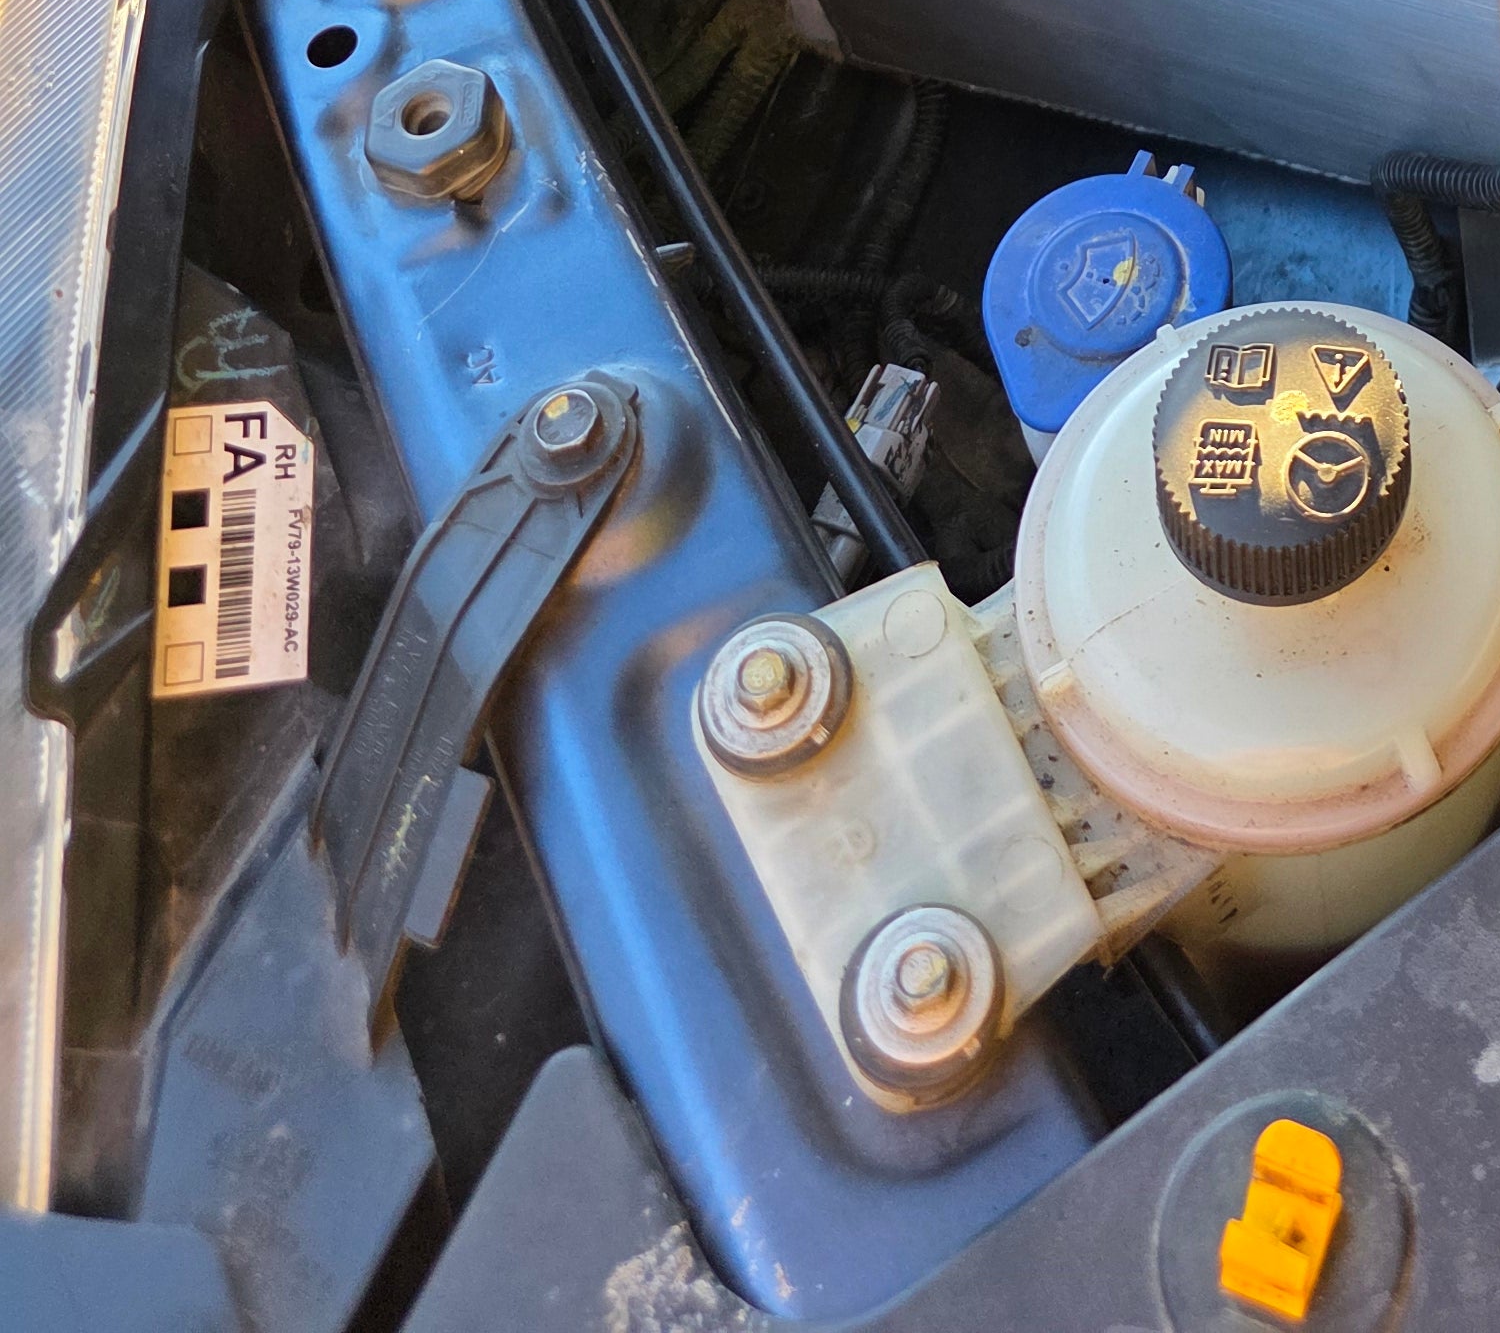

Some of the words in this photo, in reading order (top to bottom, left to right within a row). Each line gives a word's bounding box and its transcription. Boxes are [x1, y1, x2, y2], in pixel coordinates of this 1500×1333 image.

[223, 411, 268, 484] FA
[1209, 428, 1245, 444] MIN
[274, 443, 297, 481] RH
[1201, 459, 1243, 476] MAX
[283, 509, 303, 654] FV79-13W029-AC
